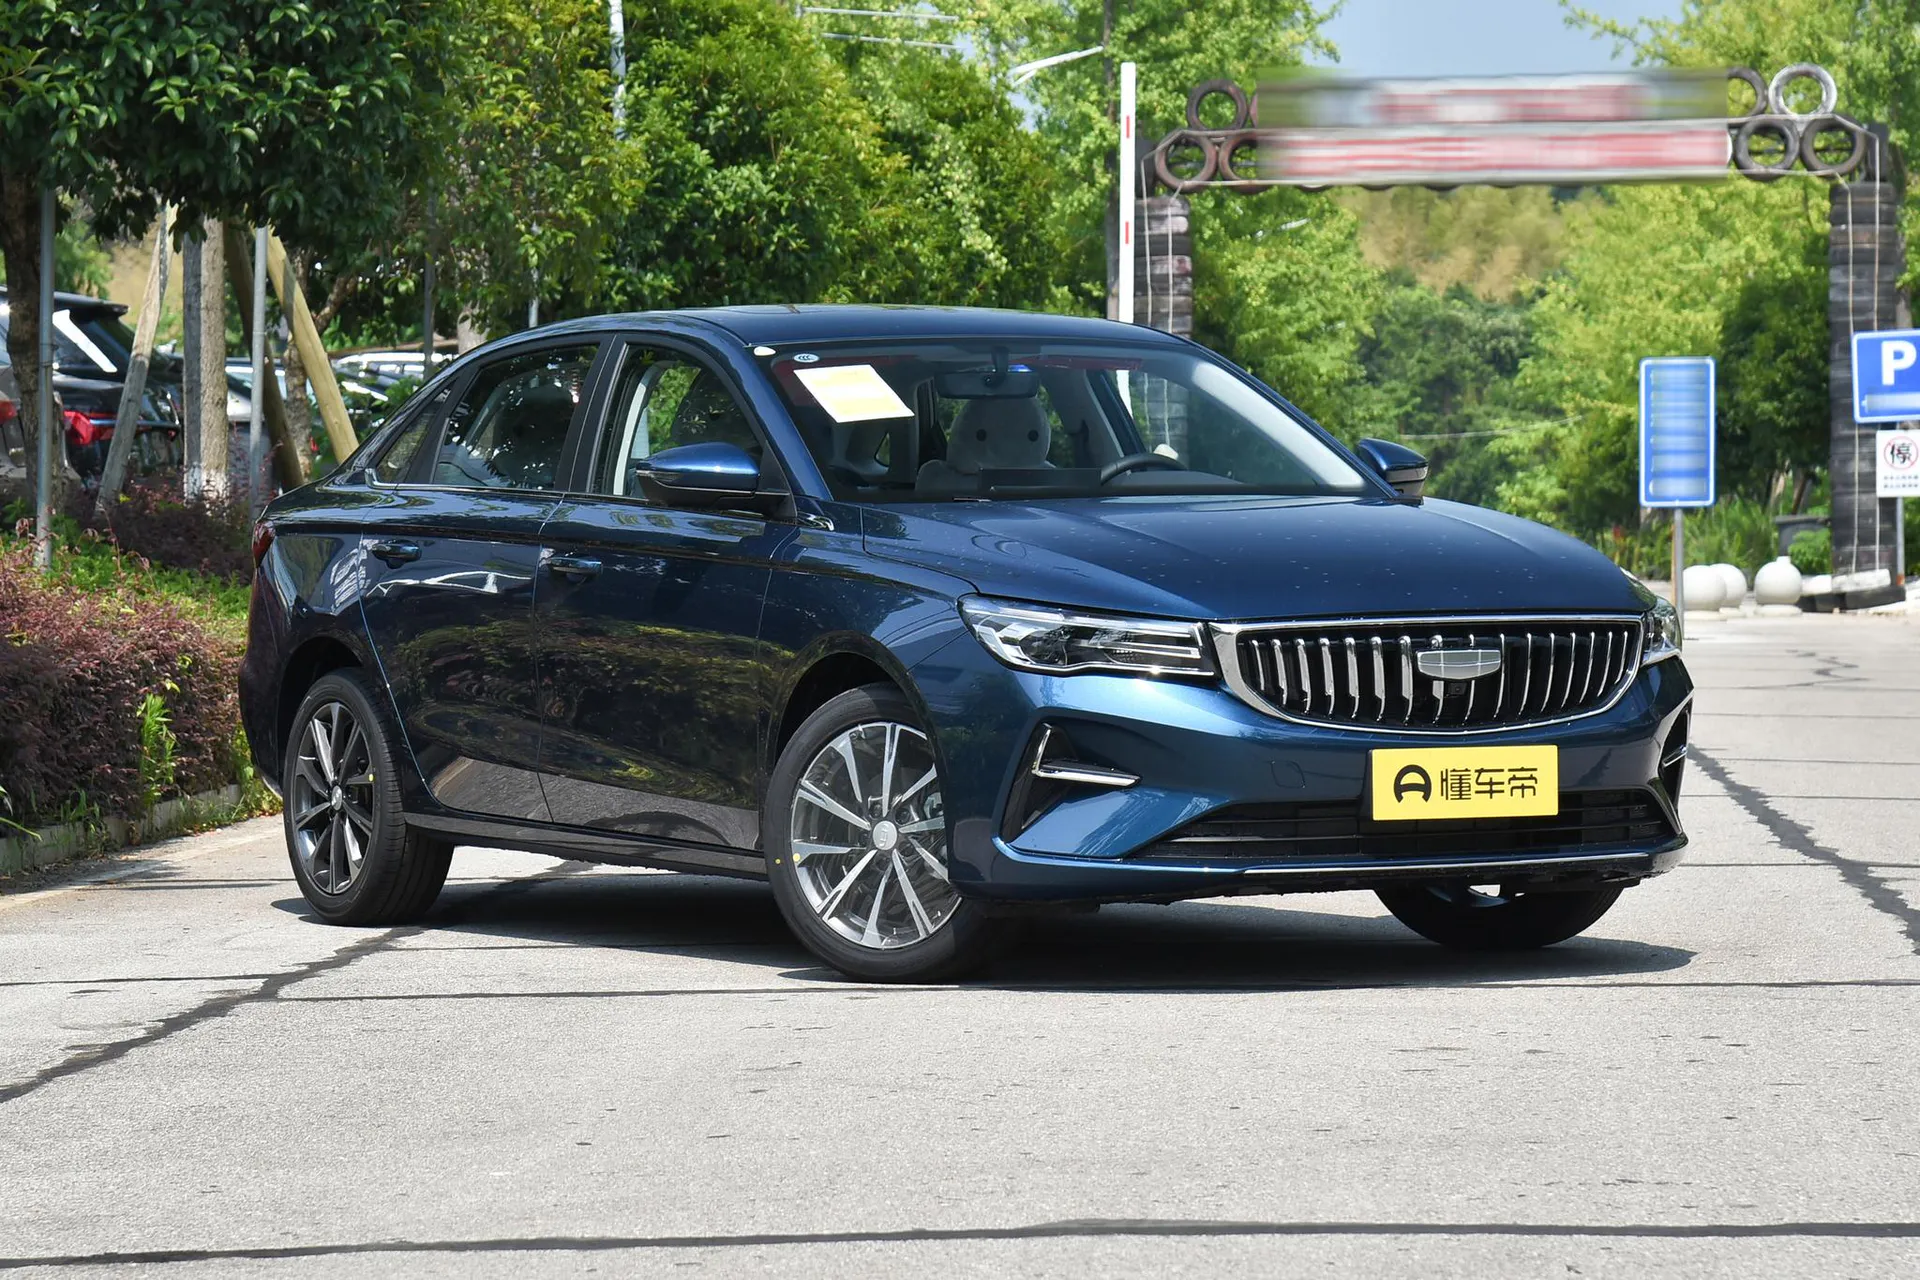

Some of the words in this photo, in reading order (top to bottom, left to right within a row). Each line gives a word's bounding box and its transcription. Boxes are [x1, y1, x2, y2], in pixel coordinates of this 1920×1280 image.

[1882, 341, 1917, 385] P
[1890, 443, 1912, 464] 停
[1441, 766, 1538, 800] 懂车帝
